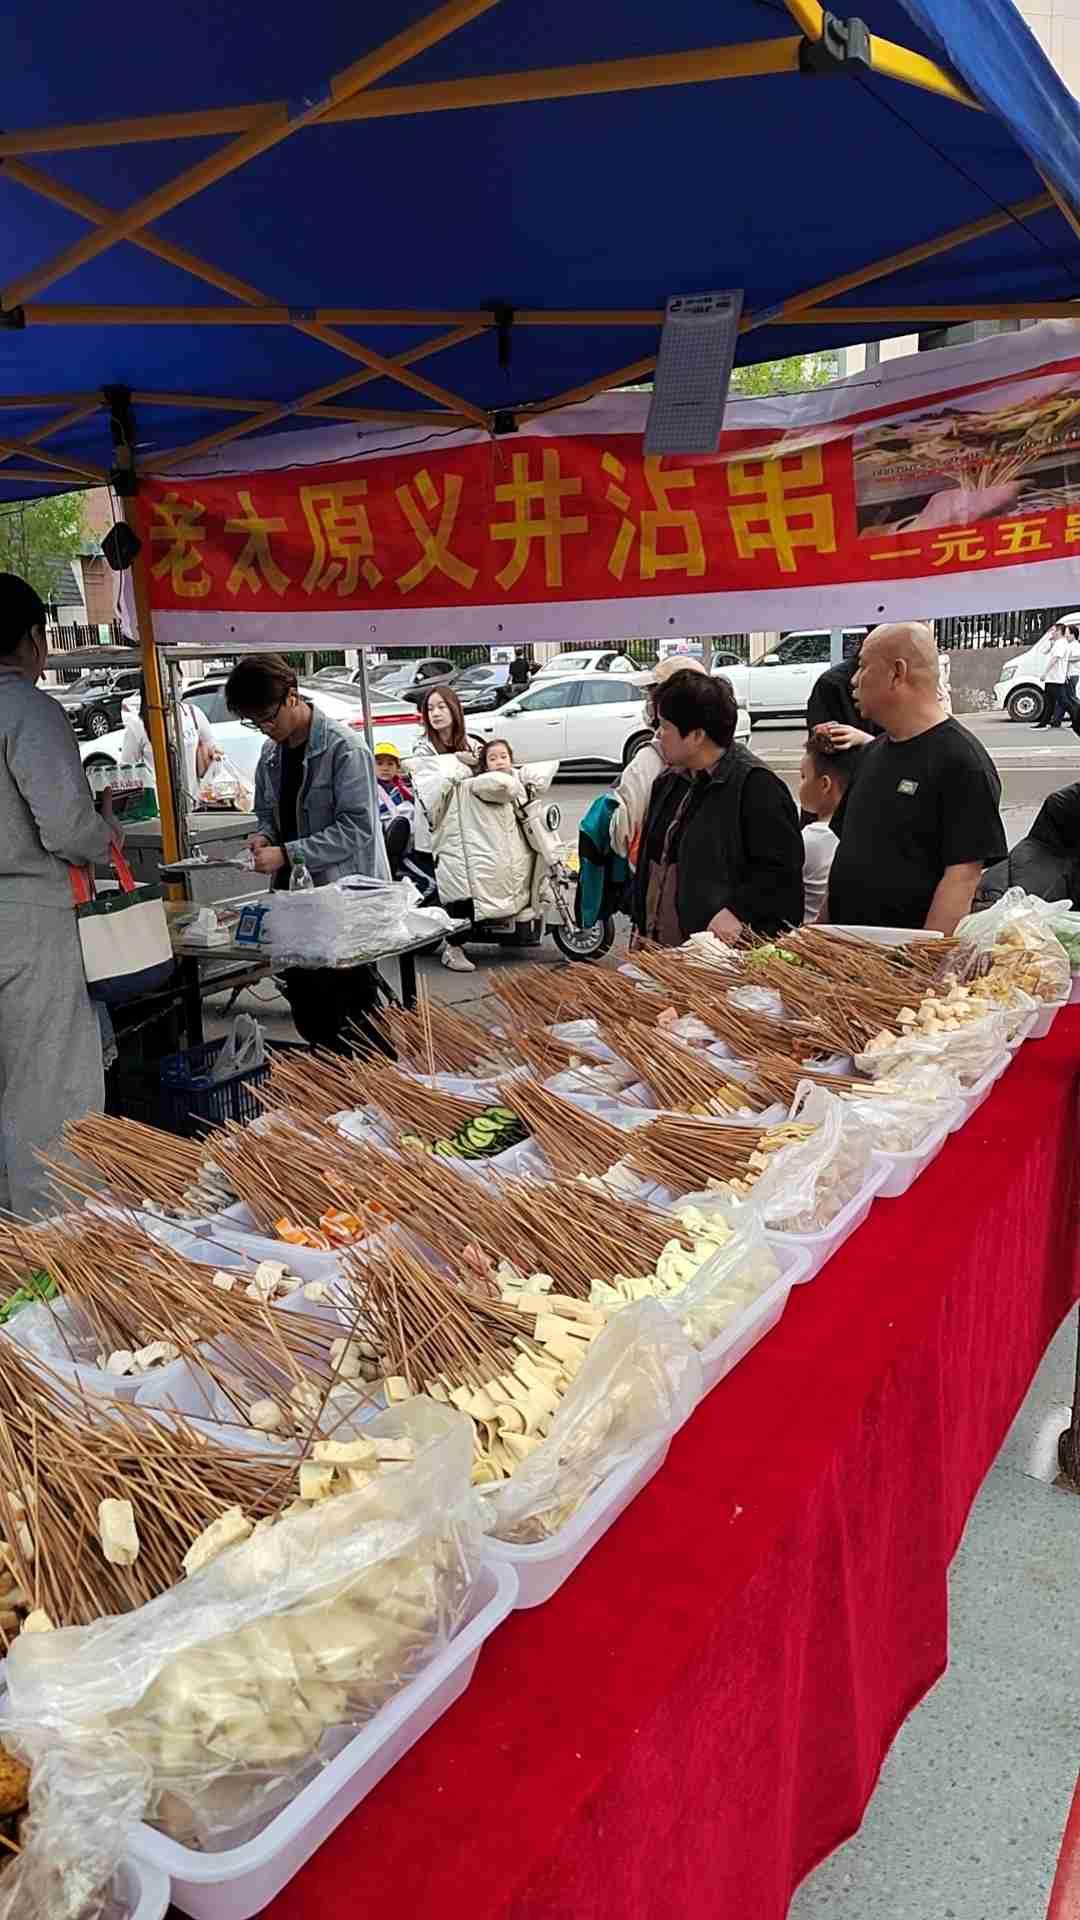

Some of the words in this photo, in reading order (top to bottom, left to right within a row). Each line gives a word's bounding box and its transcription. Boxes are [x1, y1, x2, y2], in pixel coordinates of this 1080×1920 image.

[149, 447, 837, 597] 老太原义井沾串
